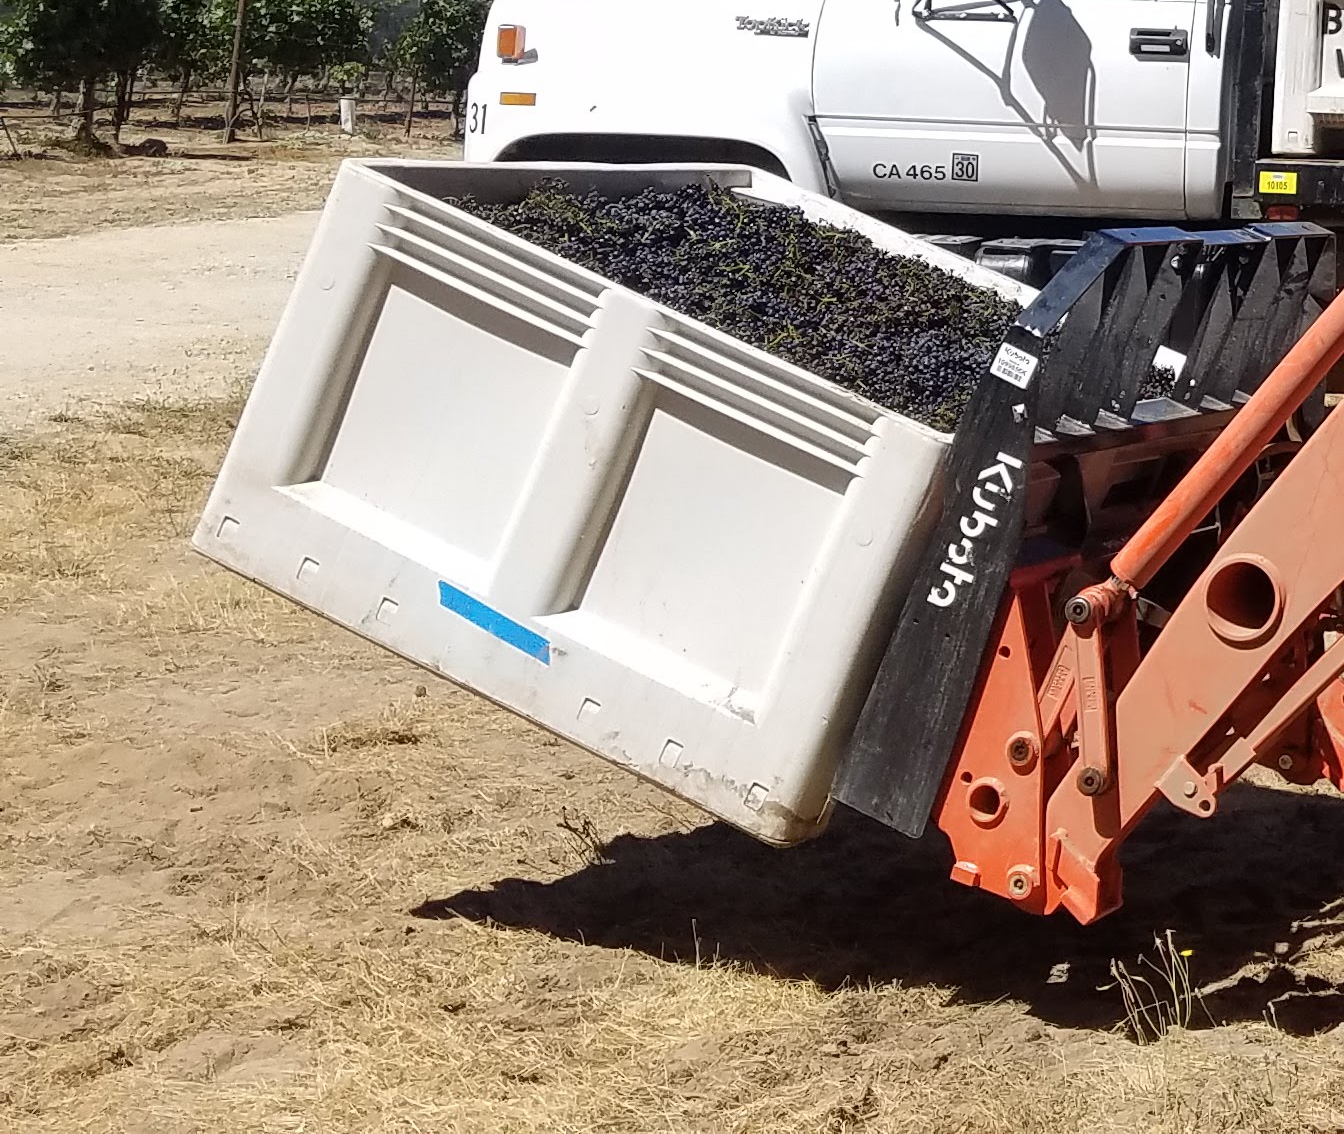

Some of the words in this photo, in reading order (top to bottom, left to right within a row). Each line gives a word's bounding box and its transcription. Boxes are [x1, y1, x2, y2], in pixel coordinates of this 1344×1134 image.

[469, 102, 488, 135] 31
[872, 162, 902, 180] CA
[905, 164, 947, 181] 465
[954, 161, 975, 179] 30
[926, 451, 1023, 607] Kubota
